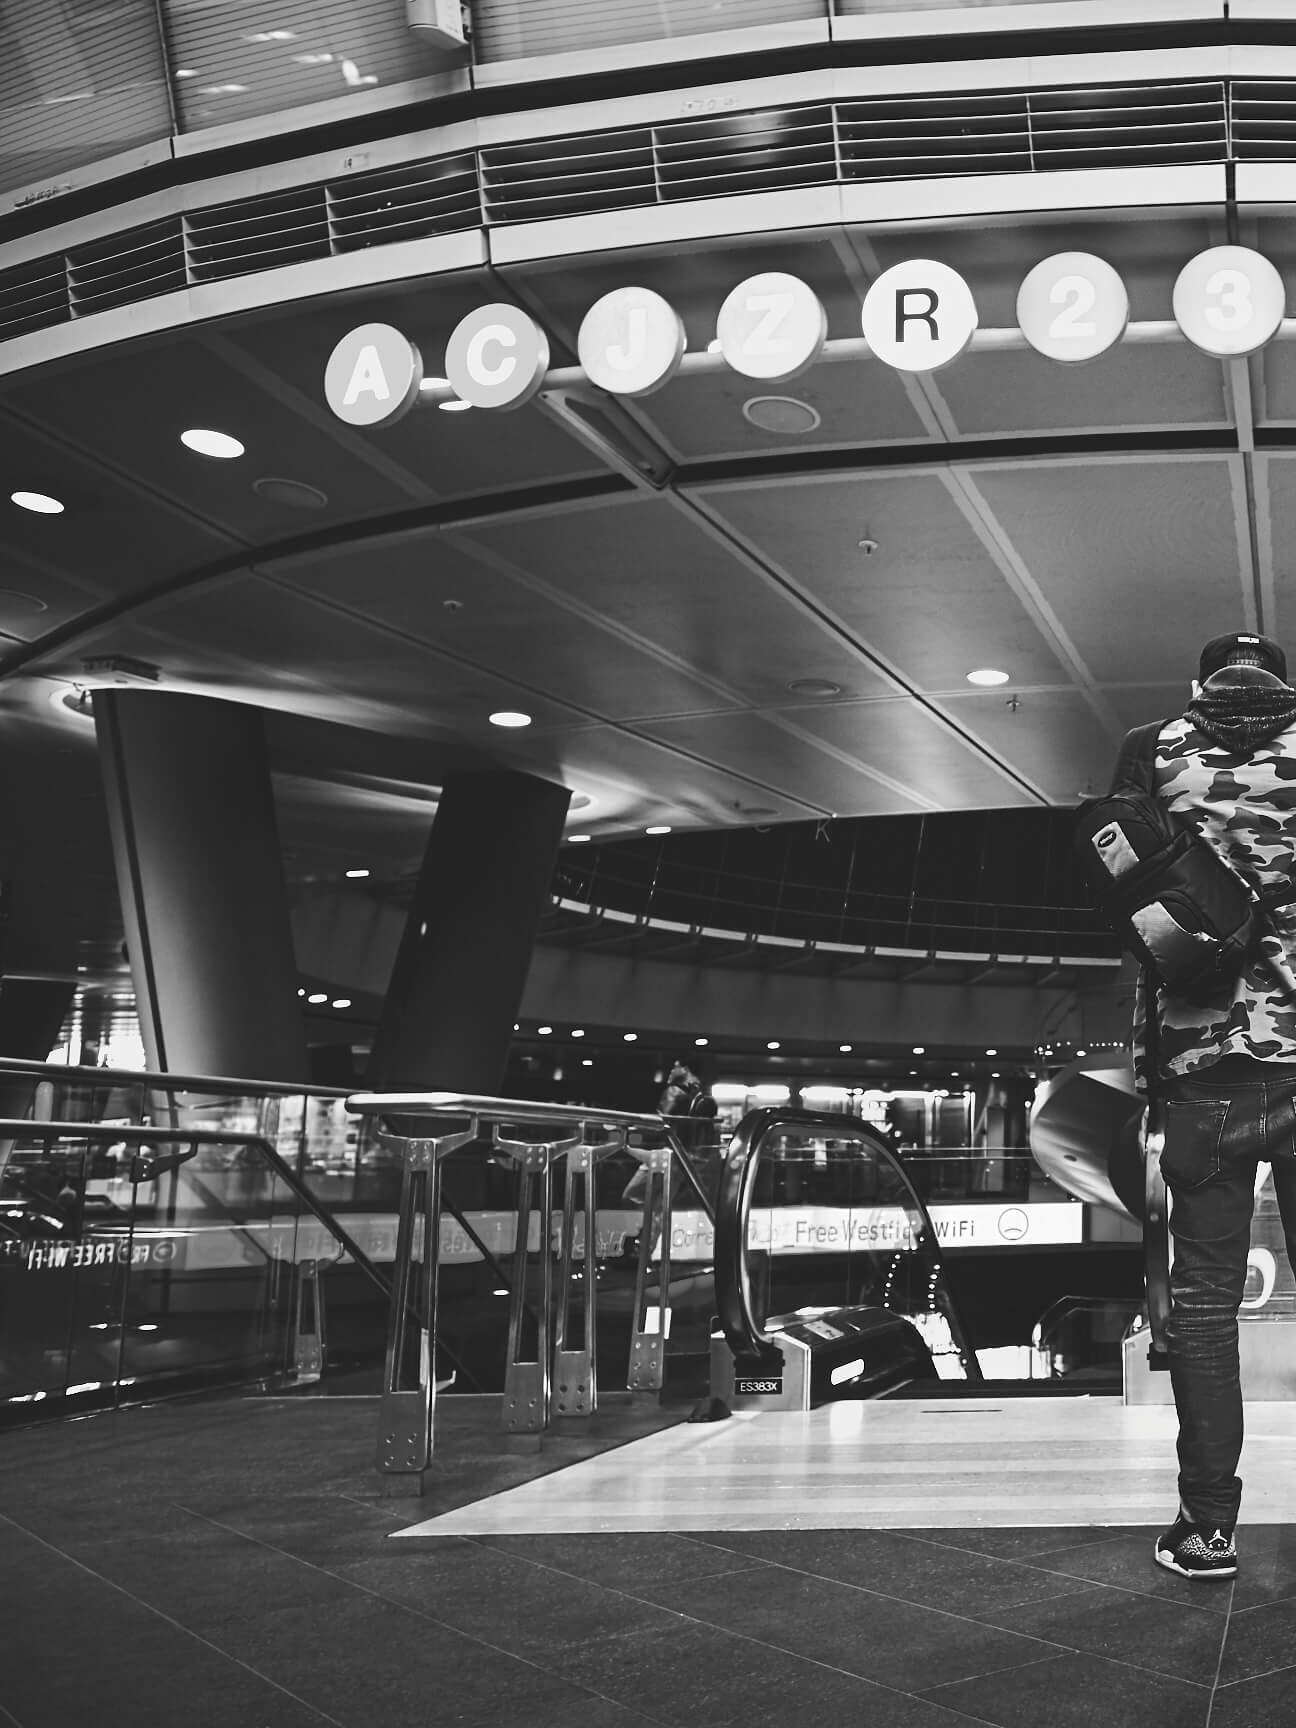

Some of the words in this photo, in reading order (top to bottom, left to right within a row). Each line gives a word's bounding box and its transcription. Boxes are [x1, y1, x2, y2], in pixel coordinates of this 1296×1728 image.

[741, 294, 794, 354] Z
[895, 288, 939, 342] R
[1048, 275, 1097, 337] 2
[1204, 270, 1252, 330] 3
[466, 324, 516, 386] C
[606, 307, 647, 369] J
[343, 345, 390, 405] A
[934, 1219, 975, 1238] WiFi
[740, 1381, 778, 1392] ES383X
